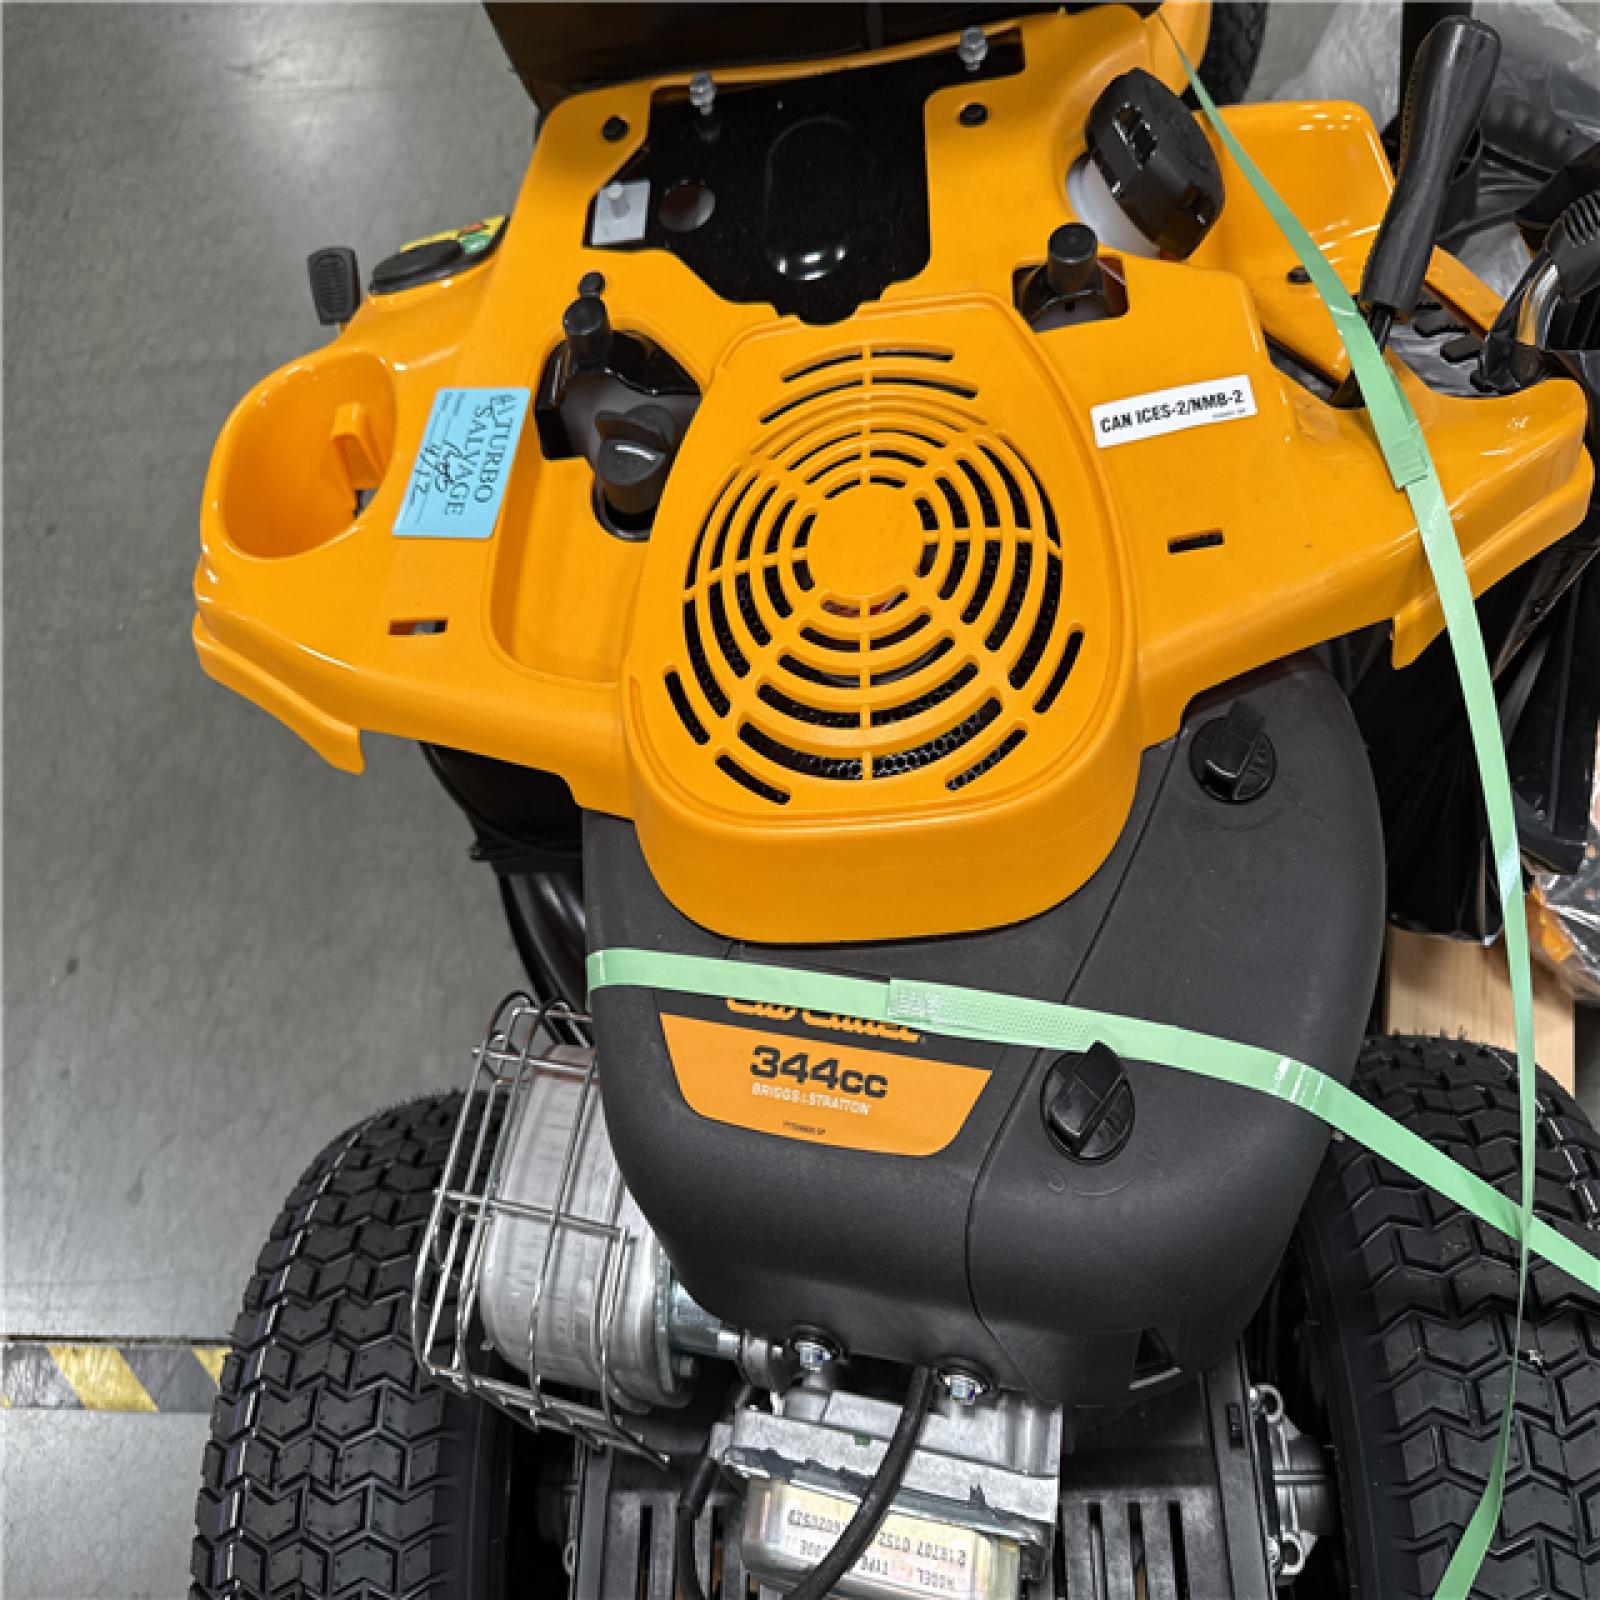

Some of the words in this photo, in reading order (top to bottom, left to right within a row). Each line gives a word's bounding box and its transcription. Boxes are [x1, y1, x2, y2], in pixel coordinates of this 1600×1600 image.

[1100, 412, 1133, 433] CAN
[1135, 389, 1245, 424] ICES-2/NMB-2
[445, 405, 492, 515] SALVAGE
[751, 1045, 888, 1098] 344cc
